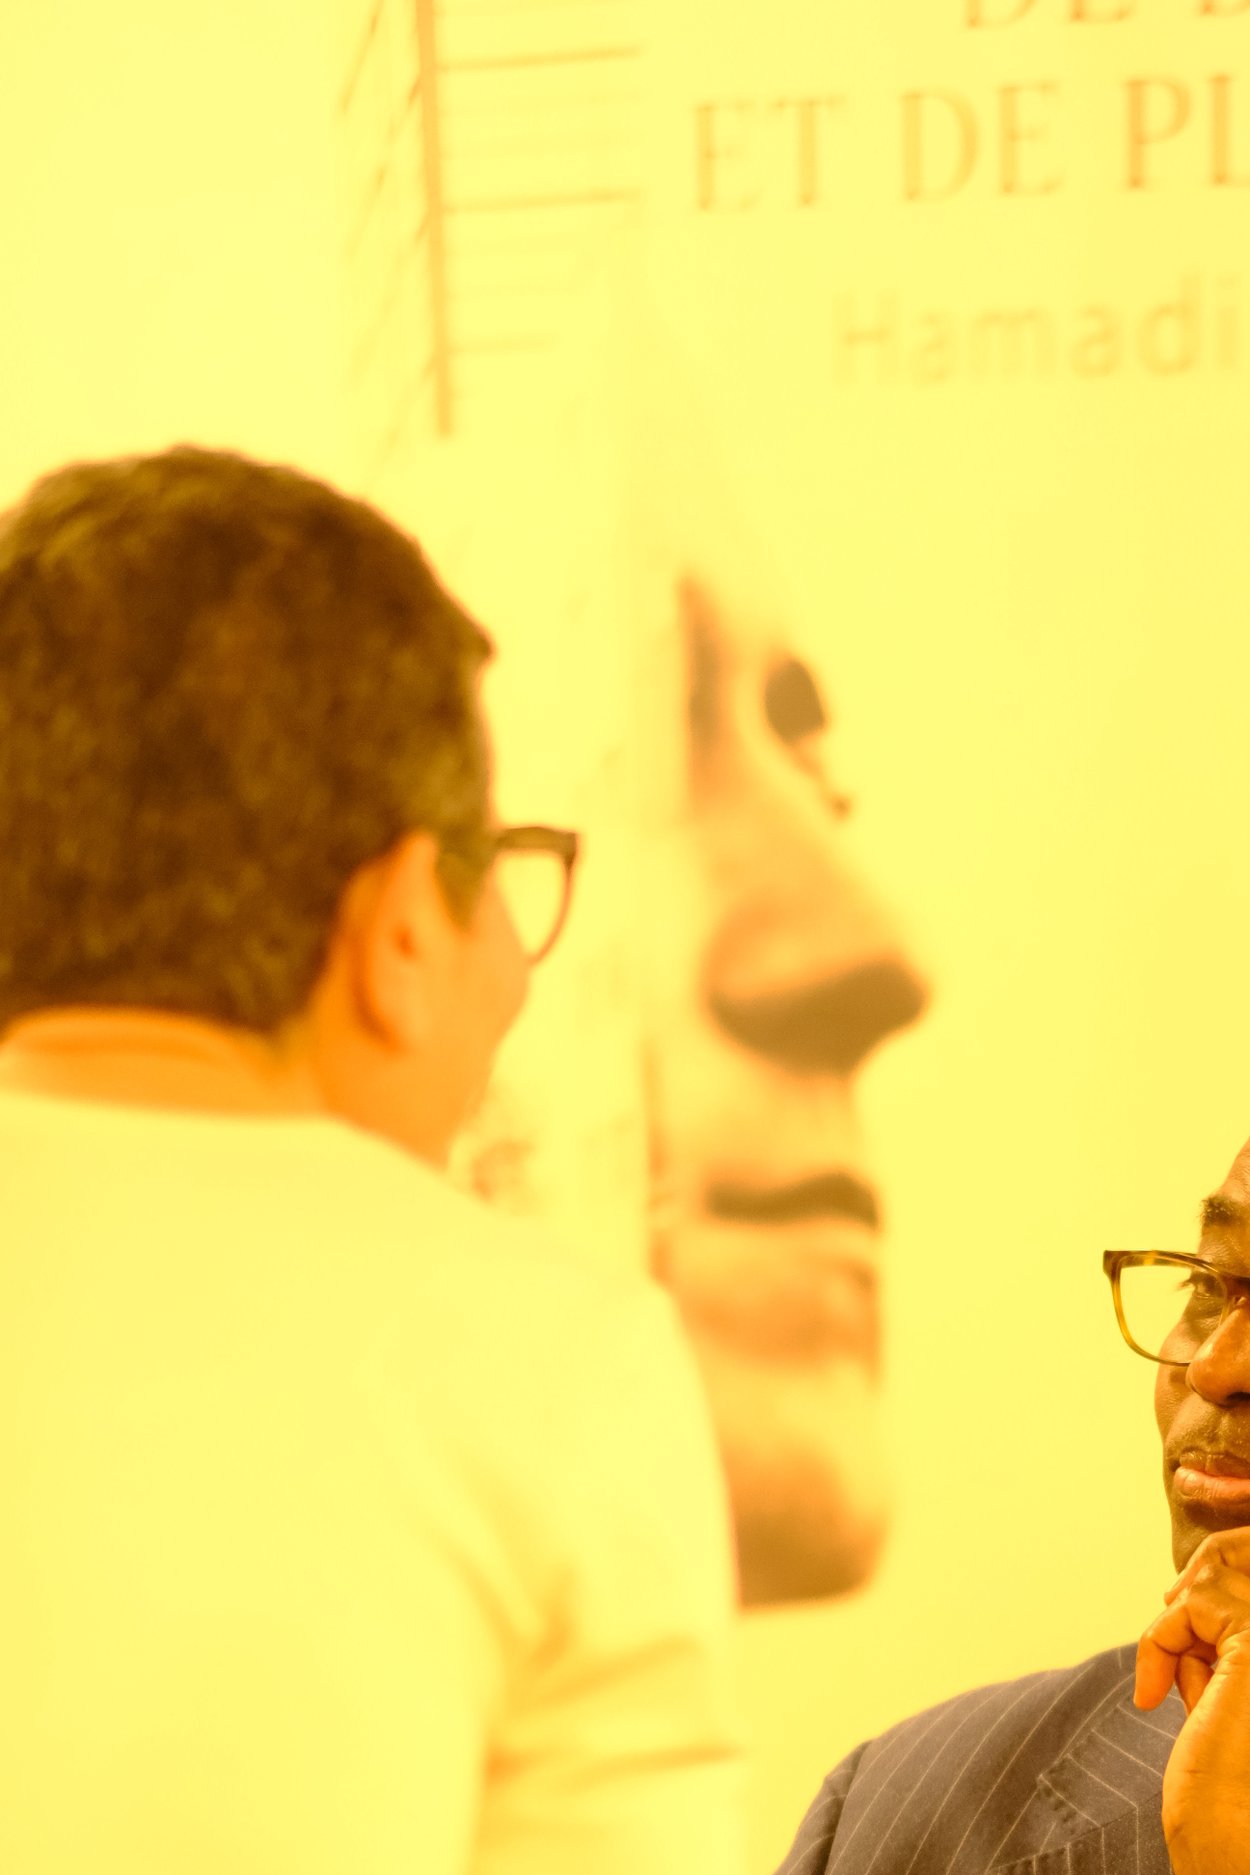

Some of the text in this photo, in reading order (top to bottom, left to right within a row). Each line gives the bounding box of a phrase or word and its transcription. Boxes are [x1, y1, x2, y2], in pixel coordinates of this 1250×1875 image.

[690, 93, 848, 213] ET
[897, 79, 1067, 205] DE
[832, 272, 1242, 386] Hamadi
